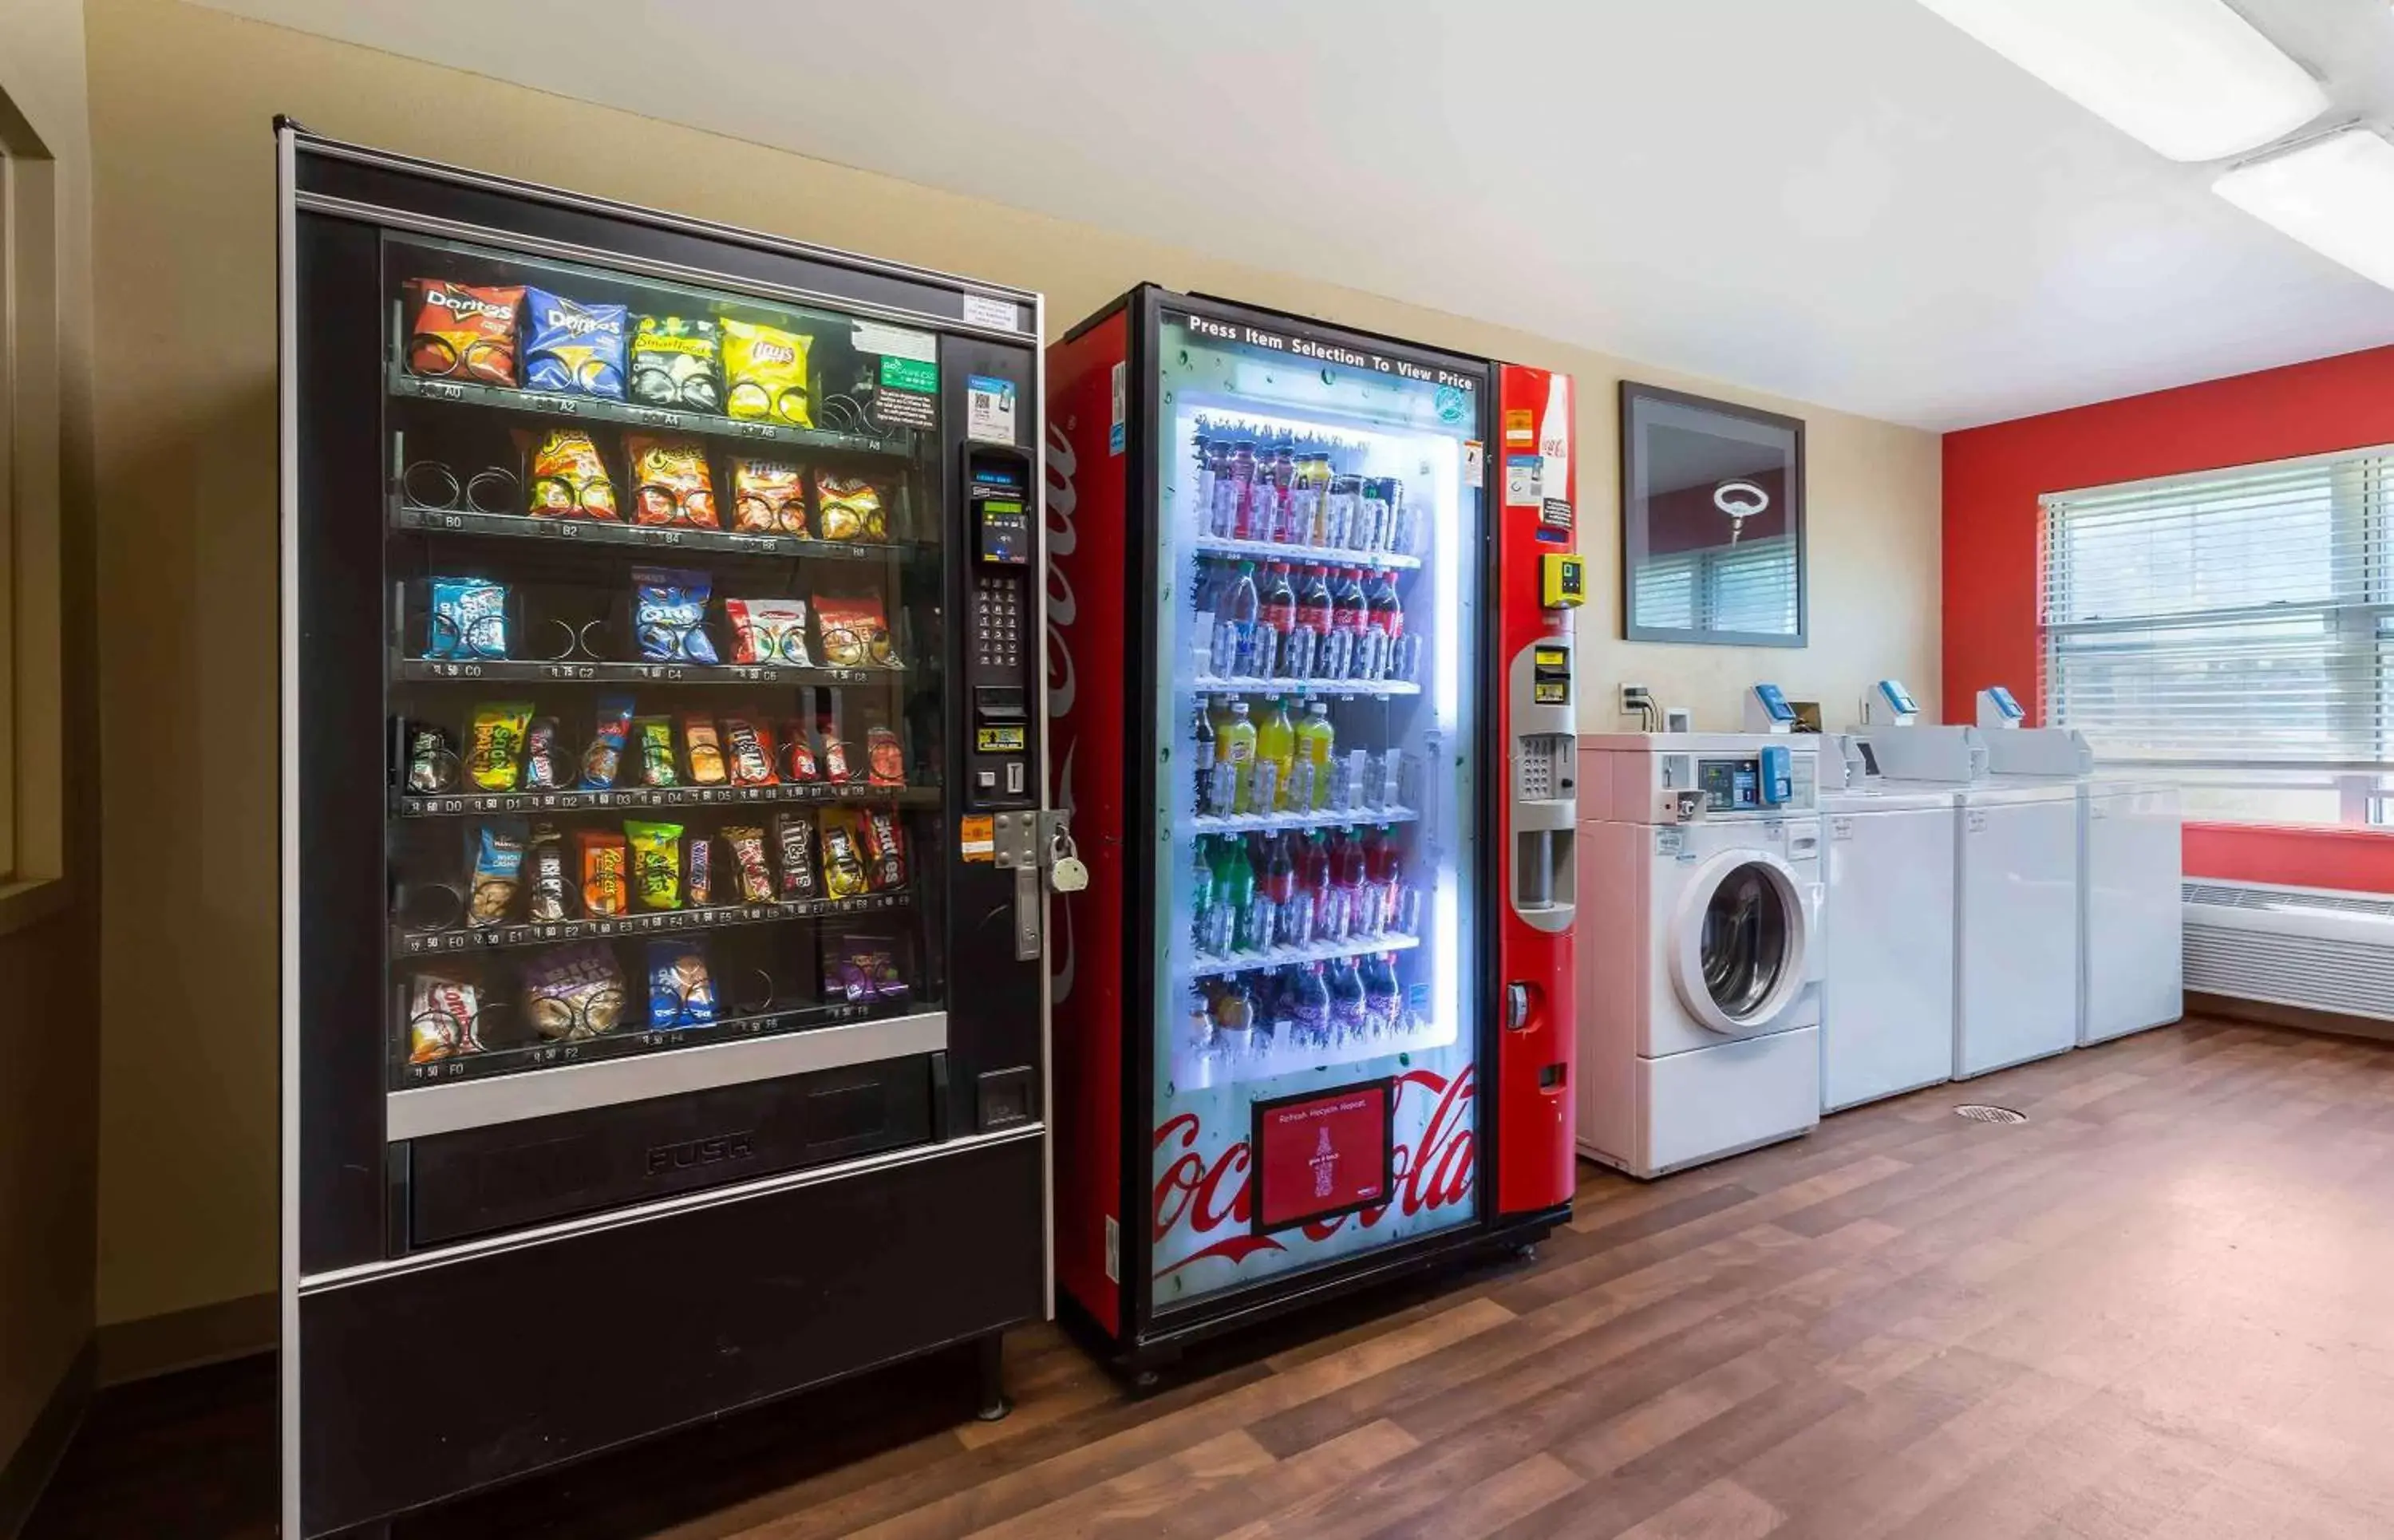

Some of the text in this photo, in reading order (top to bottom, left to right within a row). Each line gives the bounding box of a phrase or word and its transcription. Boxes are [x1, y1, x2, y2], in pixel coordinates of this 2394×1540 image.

[428, 290, 512, 318] Doritos
[547, 310, 620, 336] Doritos
[1190, 316, 1472, 391] Press Item Selection To View Price
[509, 931, 523, 942] E1
